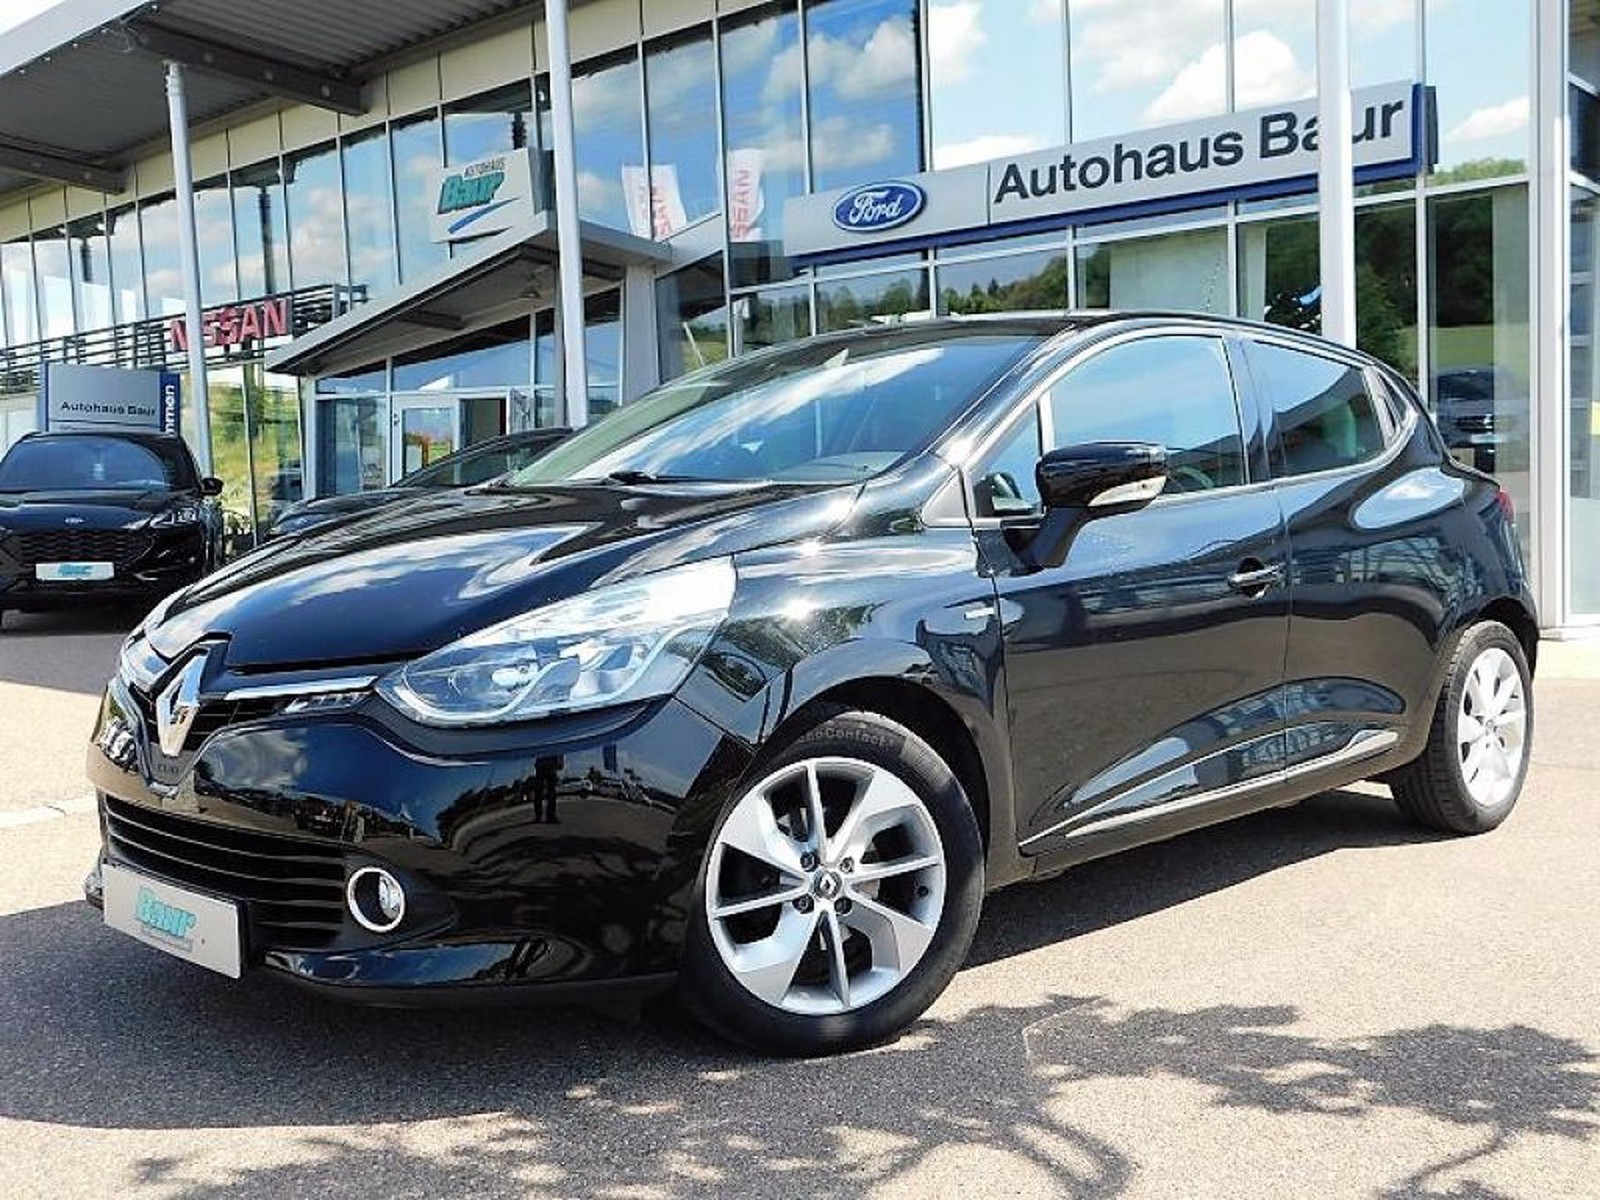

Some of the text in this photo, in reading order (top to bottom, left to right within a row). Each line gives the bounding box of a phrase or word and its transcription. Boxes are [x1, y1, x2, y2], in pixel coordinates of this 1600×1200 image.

[994, 132, 1244, 203] Autohaus
[849, 190, 904, 224] Ford
[170, 298, 287, 350] NSSAN
[61, 401, 124, 415] Autohaus
